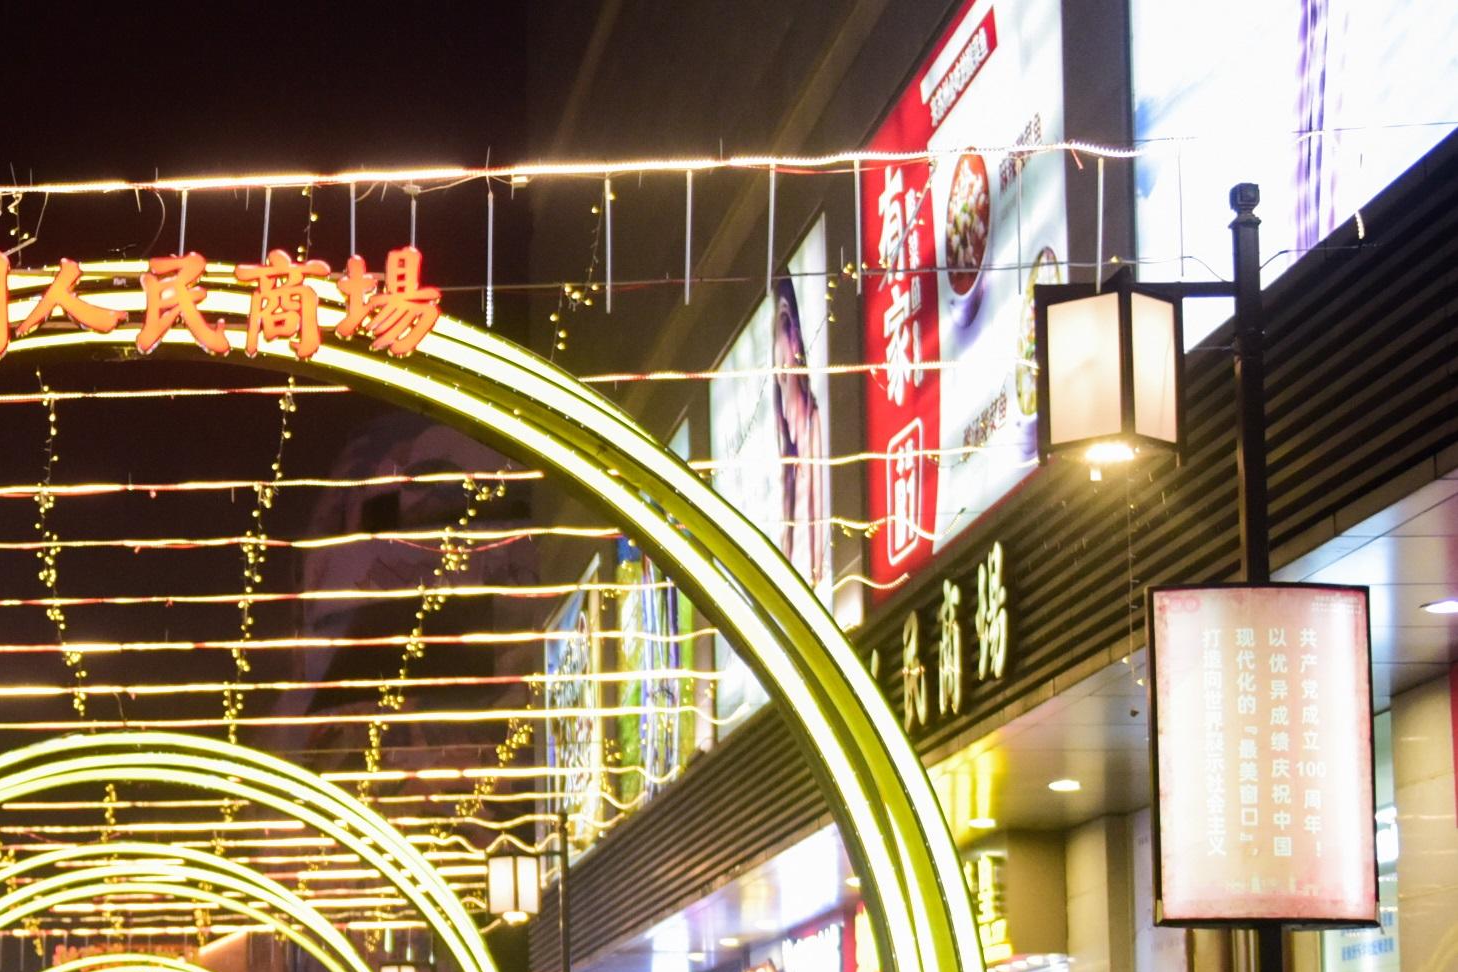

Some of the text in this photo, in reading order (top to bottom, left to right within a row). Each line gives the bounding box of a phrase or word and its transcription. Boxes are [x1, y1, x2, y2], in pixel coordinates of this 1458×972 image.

[871, 541, 1008, 734] 民商場
[1268, 628, 1292, 857] 以优异成绩庆祝中国
